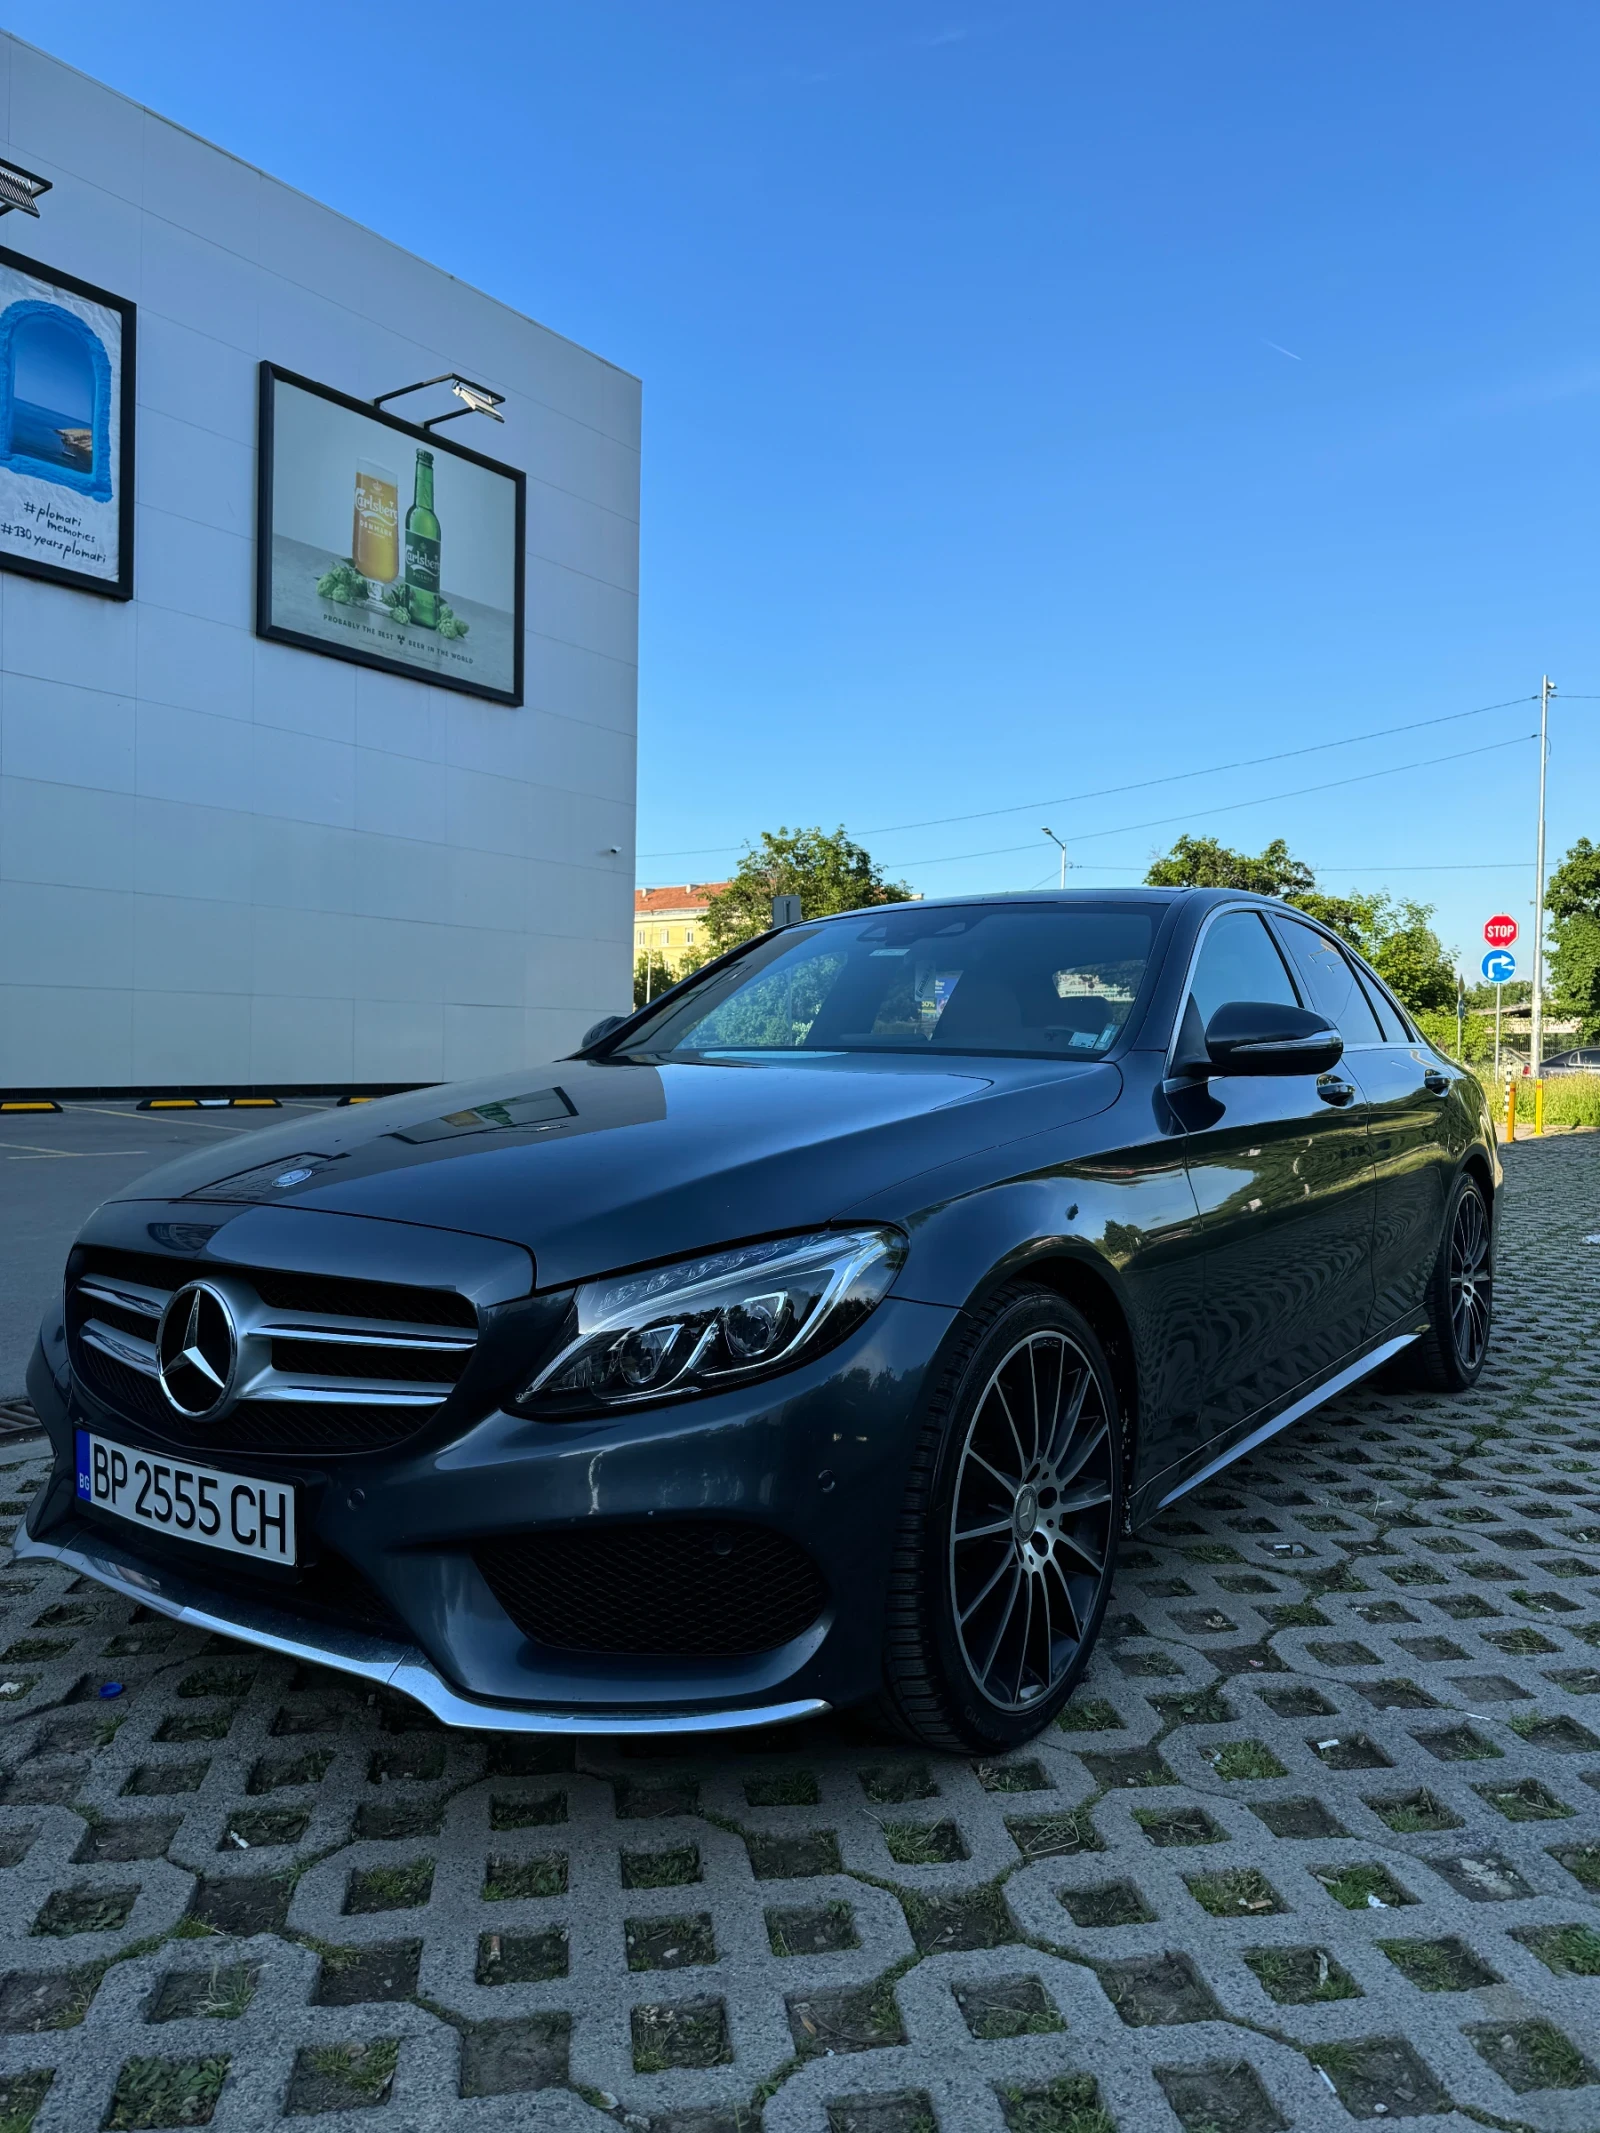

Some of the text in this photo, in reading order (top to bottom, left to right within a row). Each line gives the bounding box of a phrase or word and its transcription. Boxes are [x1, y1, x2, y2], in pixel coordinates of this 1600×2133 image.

[47, 519, 96, 543] memories
[360, 520, 392, 537] DENMARK
[323, 613, 361, 630] PROBABLY
[362, 625, 376, 635] THE
[378, 630, 394, 640] BEST
[408, 639, 425, 651] BEER
[427, 645, 435, 653] IN
[437, 648, 449, 658] THE
[451, 652, 474, 665] WORLD
[1487, 925, 1515, 938] STOP
[79, 1472, 90, 1491] BG
[93, 1443, 286, 1553] BP 2555 CH
